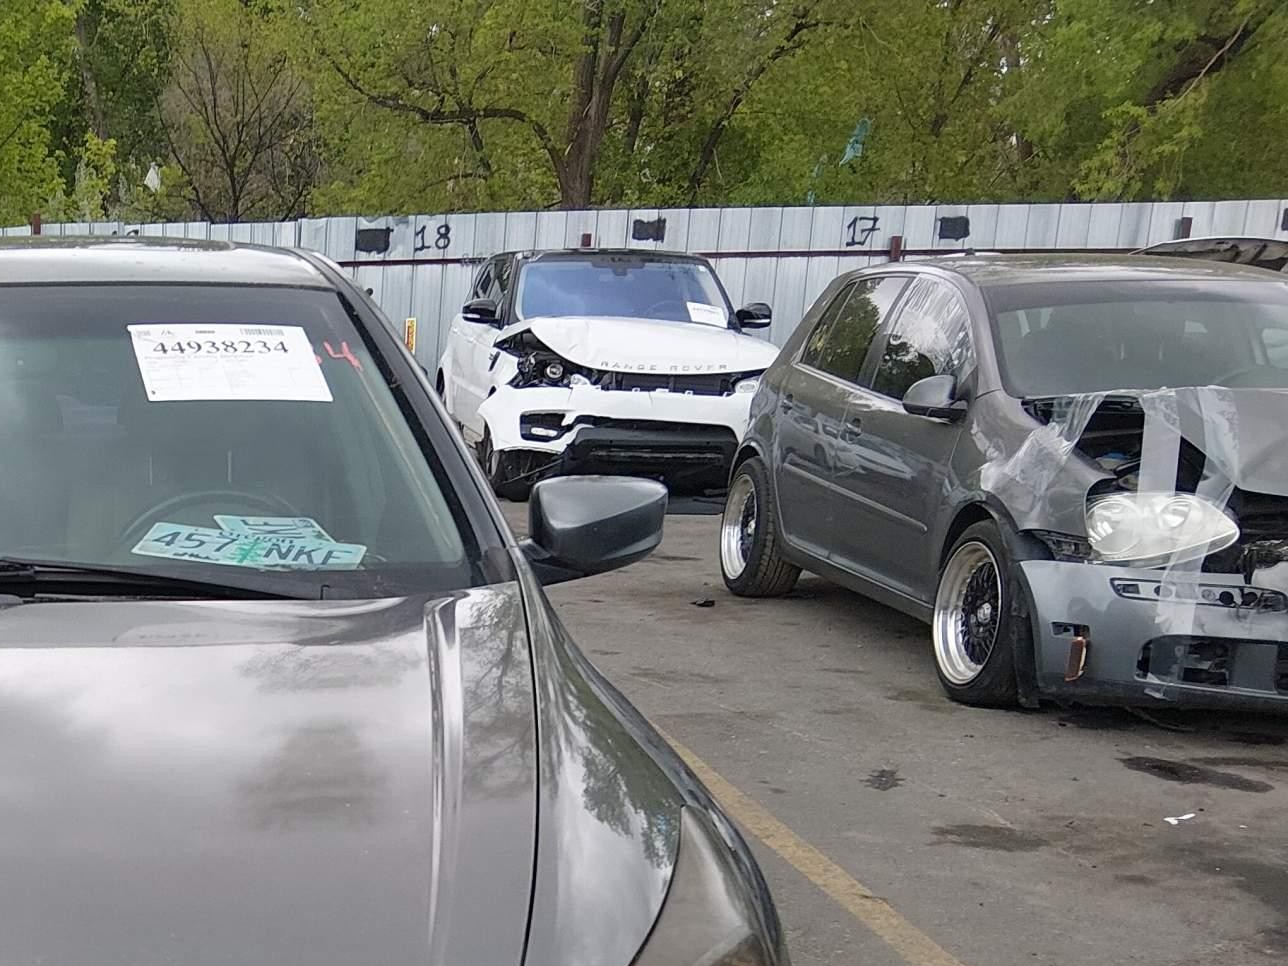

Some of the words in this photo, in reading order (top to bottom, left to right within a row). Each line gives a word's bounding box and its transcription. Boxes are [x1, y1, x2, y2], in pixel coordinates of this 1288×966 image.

[414, 224, 451, 252] 18
[845, 216, 881, 247] 17
[152, 339, 289, 355] 44938234
[152, 530, 238, 553] 457
